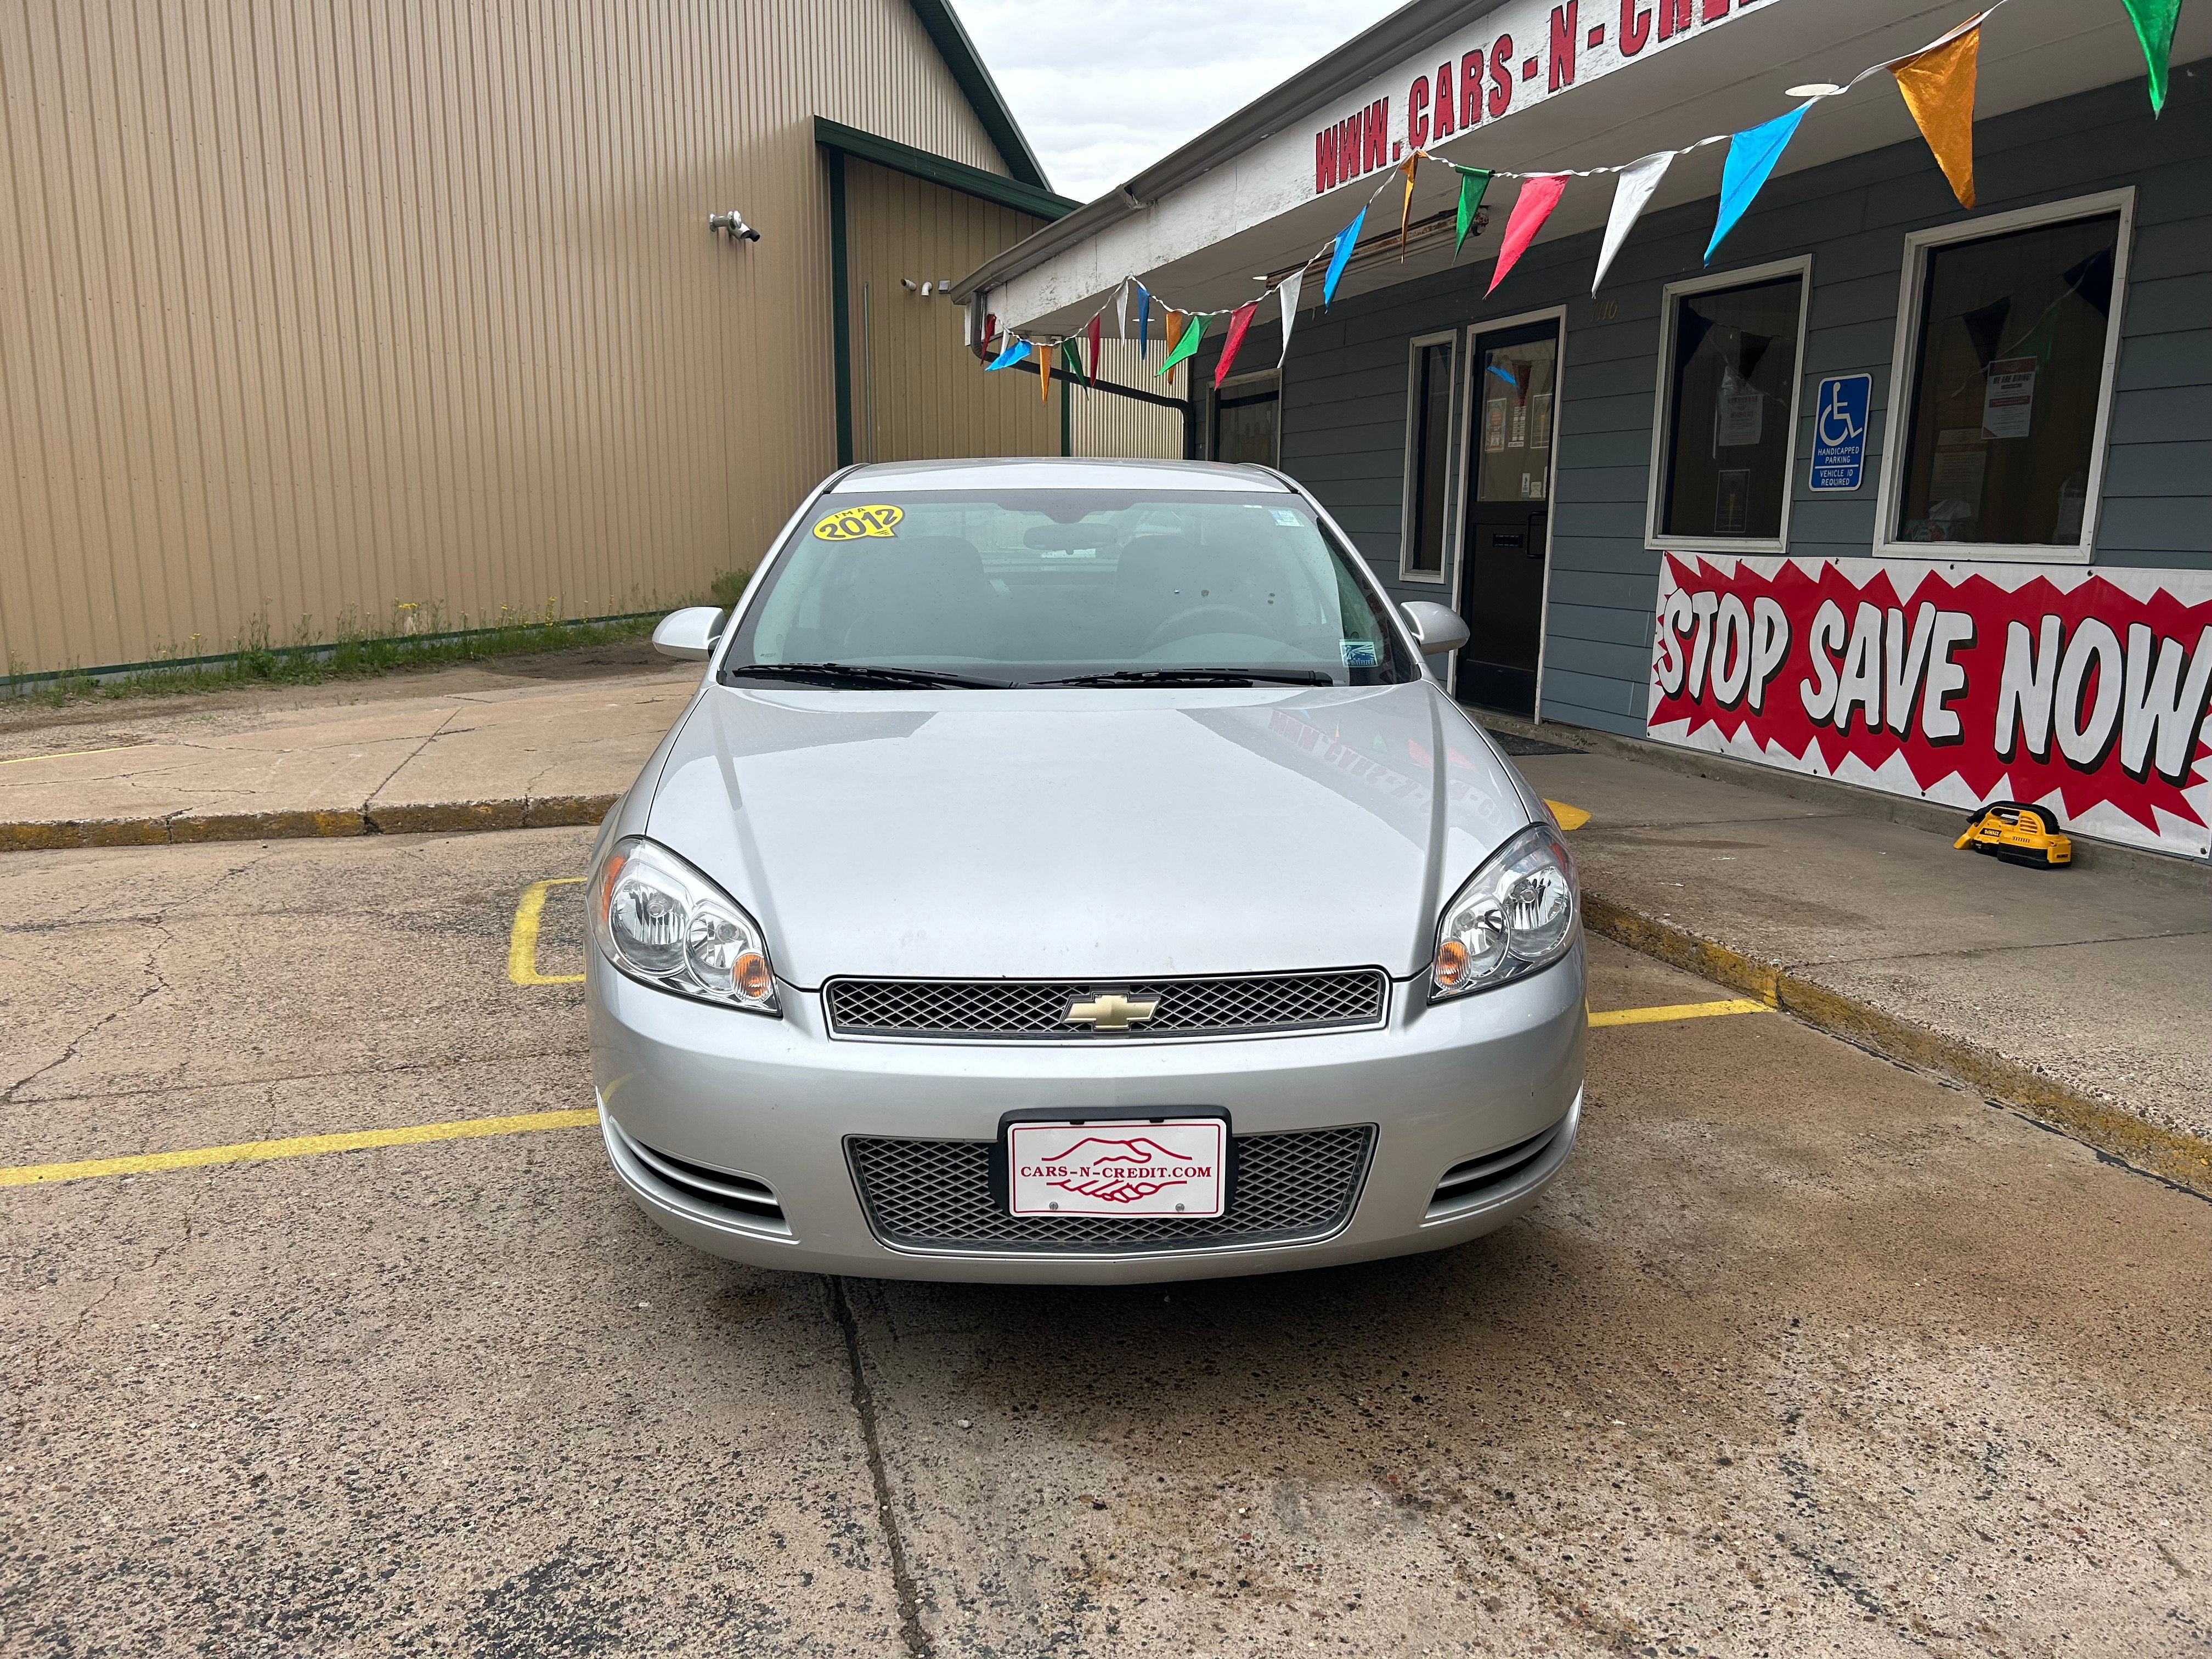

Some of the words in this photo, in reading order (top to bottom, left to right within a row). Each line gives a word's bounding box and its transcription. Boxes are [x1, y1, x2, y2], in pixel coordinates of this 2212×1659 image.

[1818, 447, 1859, 456] HANDICAPPED
[1825, 455, 1850, 464] PARKING
[1820, 469, 1844, 477] VEHICLE
[1821, 478, 1849, 486] REQUIRED
[820, 509, 898, 538] 2012
[1658, 588, 1793, 716] STOP
[1799, 598, 1977, 748] SAVE
[1994, 613, 2212, 788] NOW
[1020, 1166, 1212, 1178] CARS-N-CREDIT.COM
